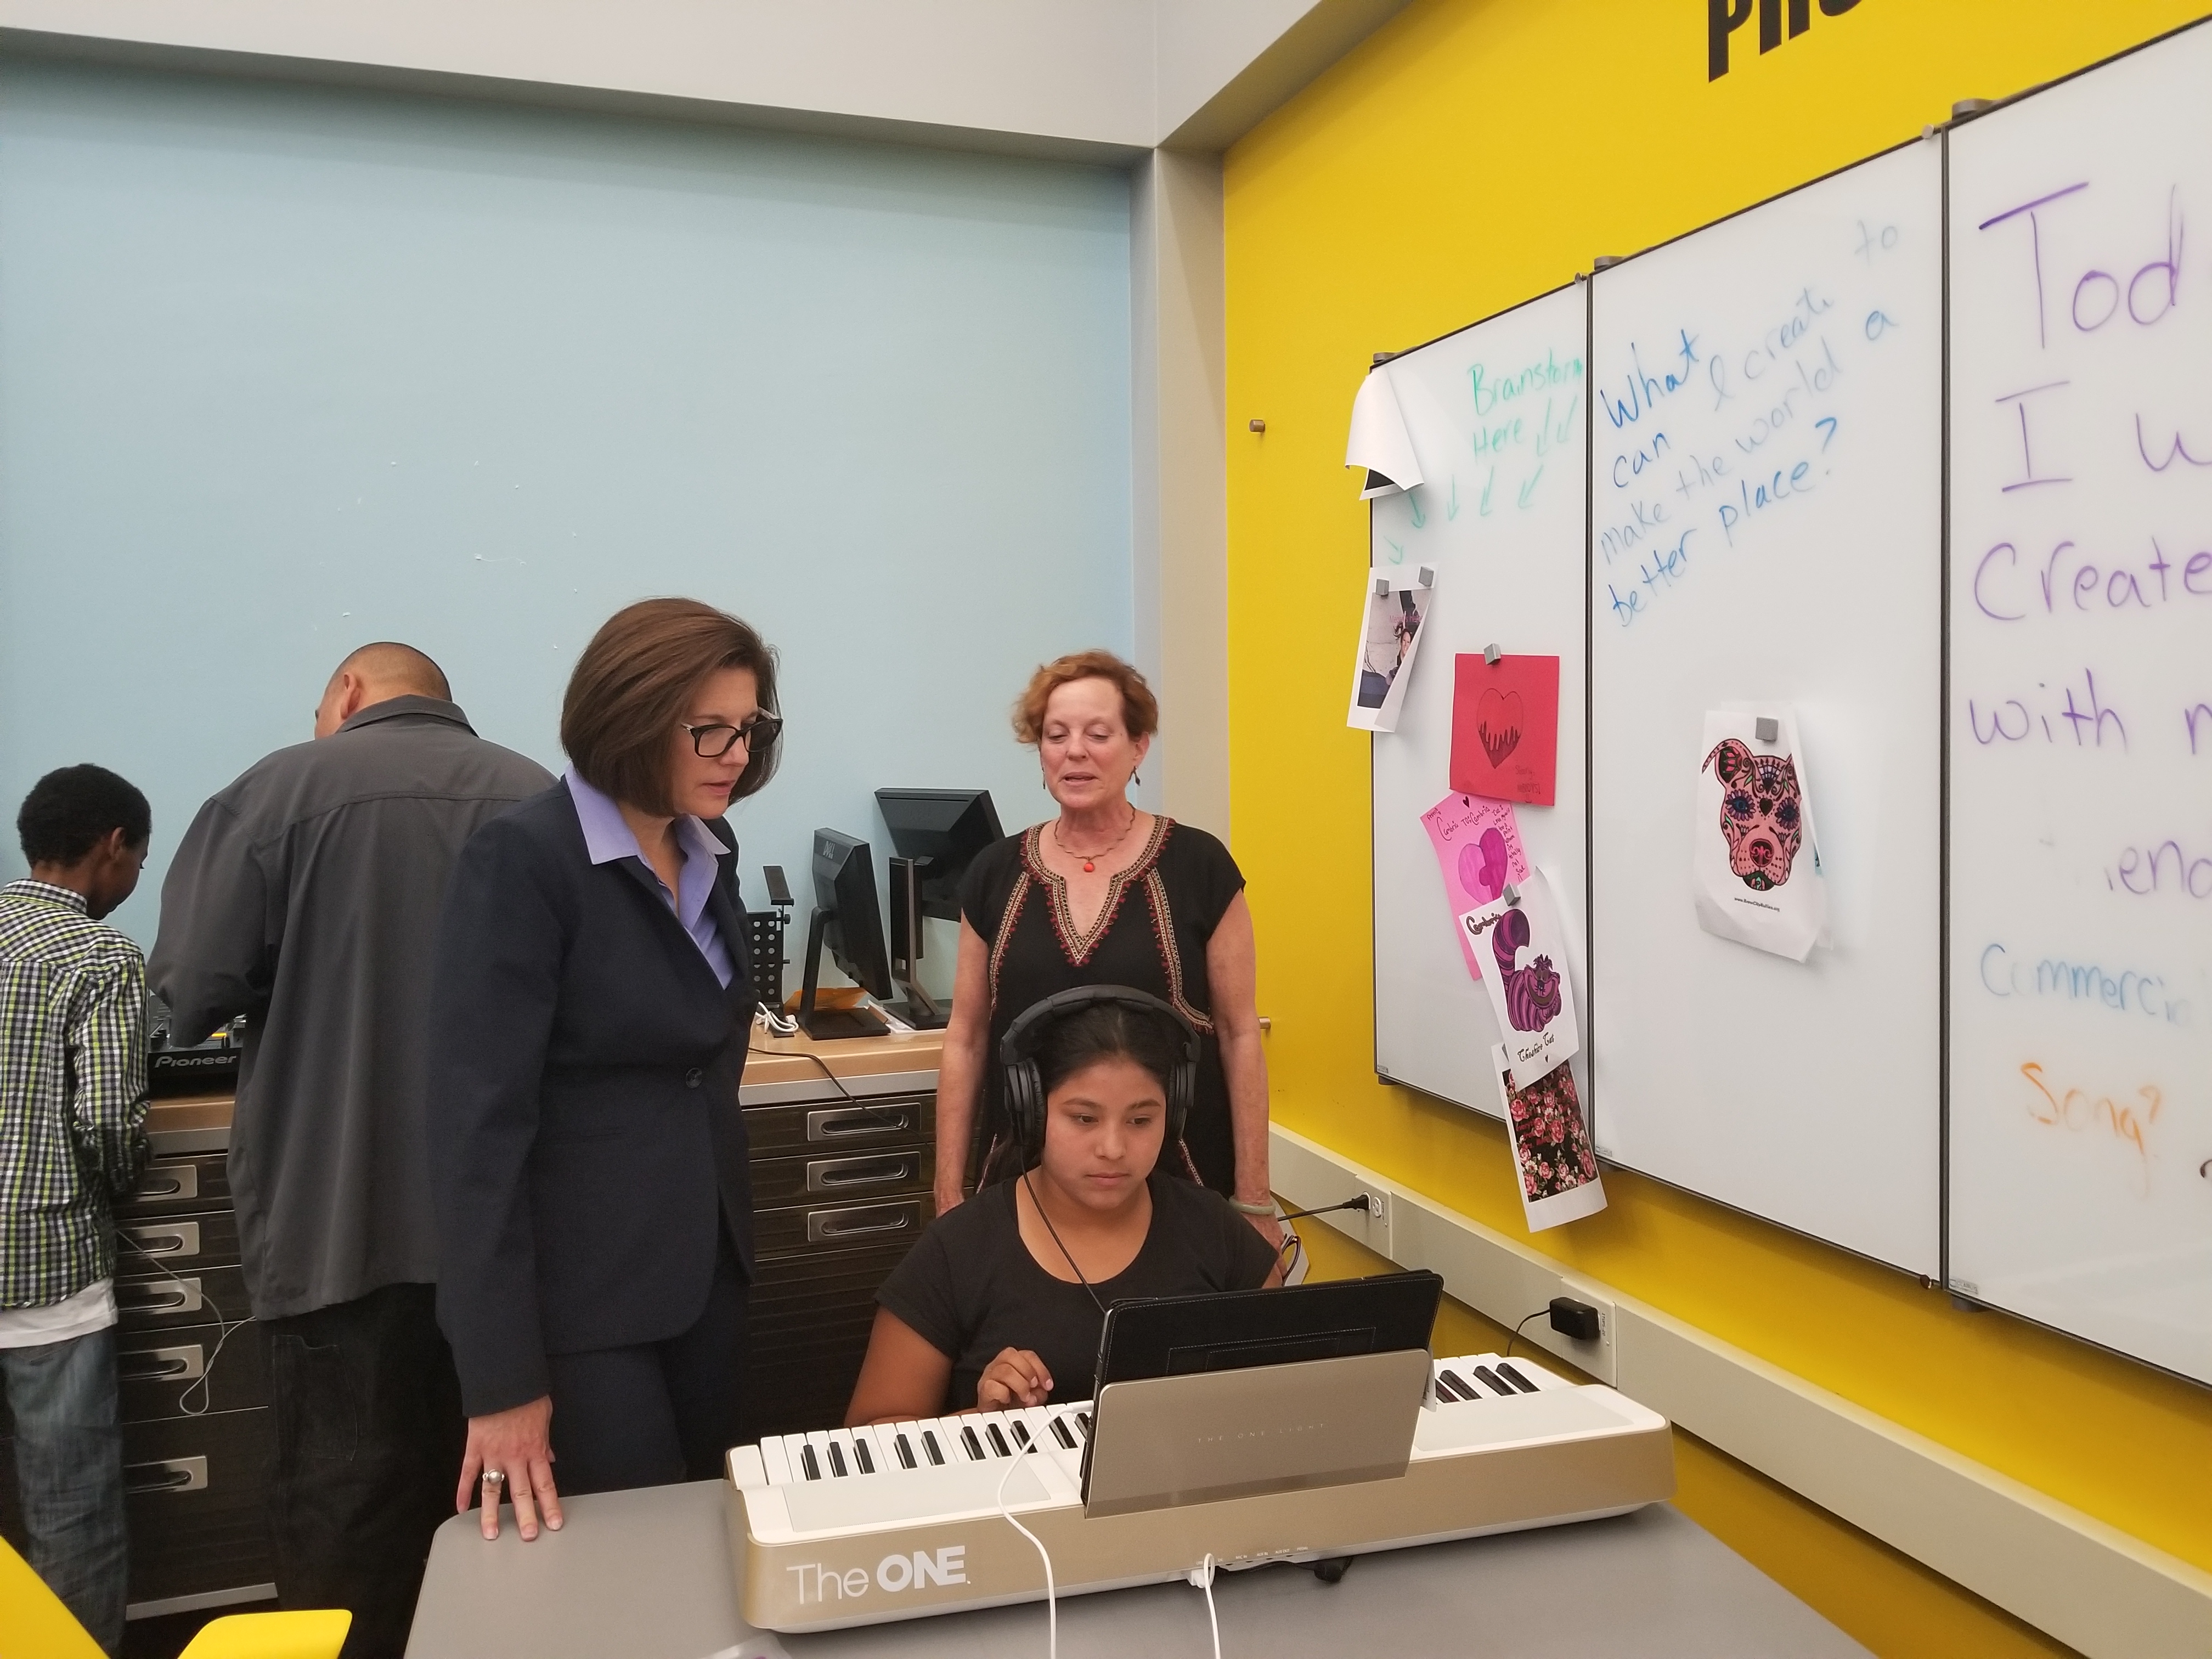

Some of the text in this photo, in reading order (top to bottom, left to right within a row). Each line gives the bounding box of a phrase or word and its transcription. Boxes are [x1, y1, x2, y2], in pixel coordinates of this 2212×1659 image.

[1599, 328, 1700, 428] What
[1472, 418, 1522, 462] Here
[1601, 310, 1899, 565] make the world a
[1613, 432, 1671, 488] can
[1995, 381, 2073, 493] I
[1608, 417, 1837, 627] better place?
[1974, 535, 2212, 620] Create
[1970, 667, 2128, 755] with
[154, 1055, 237, 1068] Pioneer
[1198, 1423, 1323, 1443] THE ONE LIGHT
[786, 1562, 869, 1605] The
